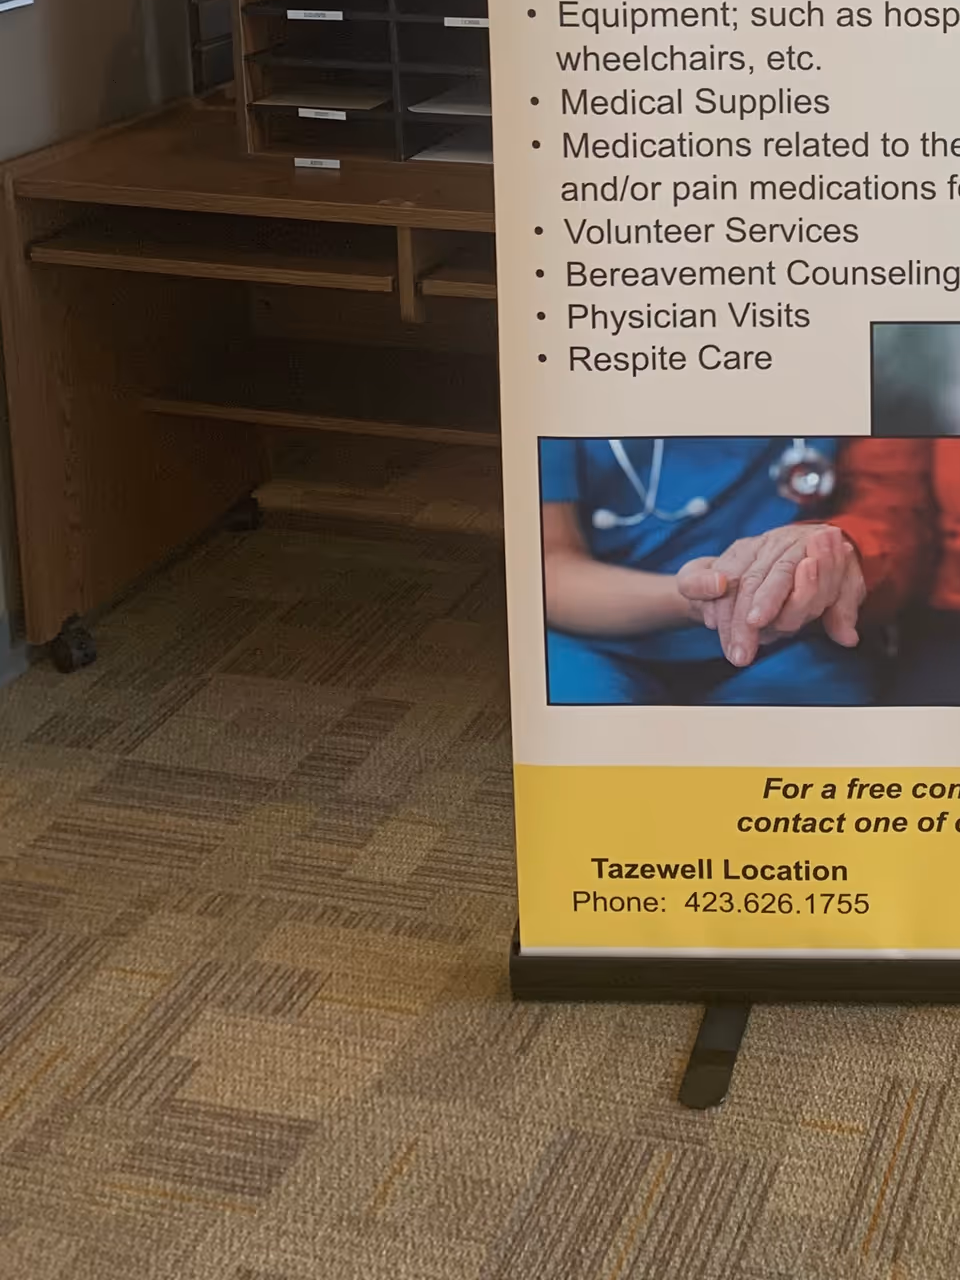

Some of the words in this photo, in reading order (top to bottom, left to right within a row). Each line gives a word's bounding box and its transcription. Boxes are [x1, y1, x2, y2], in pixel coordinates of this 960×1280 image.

[559, 1, 737, 34] Equipment;
[751, 1, 823, 26] such
[837, 8, 872, 27] as
[556, 45, 753, 74] wheelchairs,
[767, 46, 820, 70] etc.
[562, 89, 682, 115] Medical
[696, 88, 829, 120] Supplies
[563, 132, 751, 158] Medications
[764, 132, 868, 157] related
[881, 133, 909, 157] to
[562, 175, 661, 201] and/or
[674, 175, 736, 207] pain
[751, 175, 936, 200] medications
[564, 219, 715, 244] Volunteer
[726, 217, 858, 242] Services
[567, 261, 776, 287] Bereavement
[787, 260, 959, 291] Counseling
[569, 303, 716, 335] Physician
[728, 302, 810, 327] Visits
[570, 346, 686, 377] Respite
[699, 345, 772, 369] Care
[763, 778, 813, 799] For
[821, 784, 836, 799] a
[848, 778, 902, 799] free
[738, 813, 846, 833] contact
[855, 817, 907, 832] one
[918, 812, 949, 832] of
[591, 858, 712, 879] Tazewell
[724, 859, 847, 881] Location
[574, 891, 665, 912] Phone:
[685, 892, 869, 914] 423.626.1755
